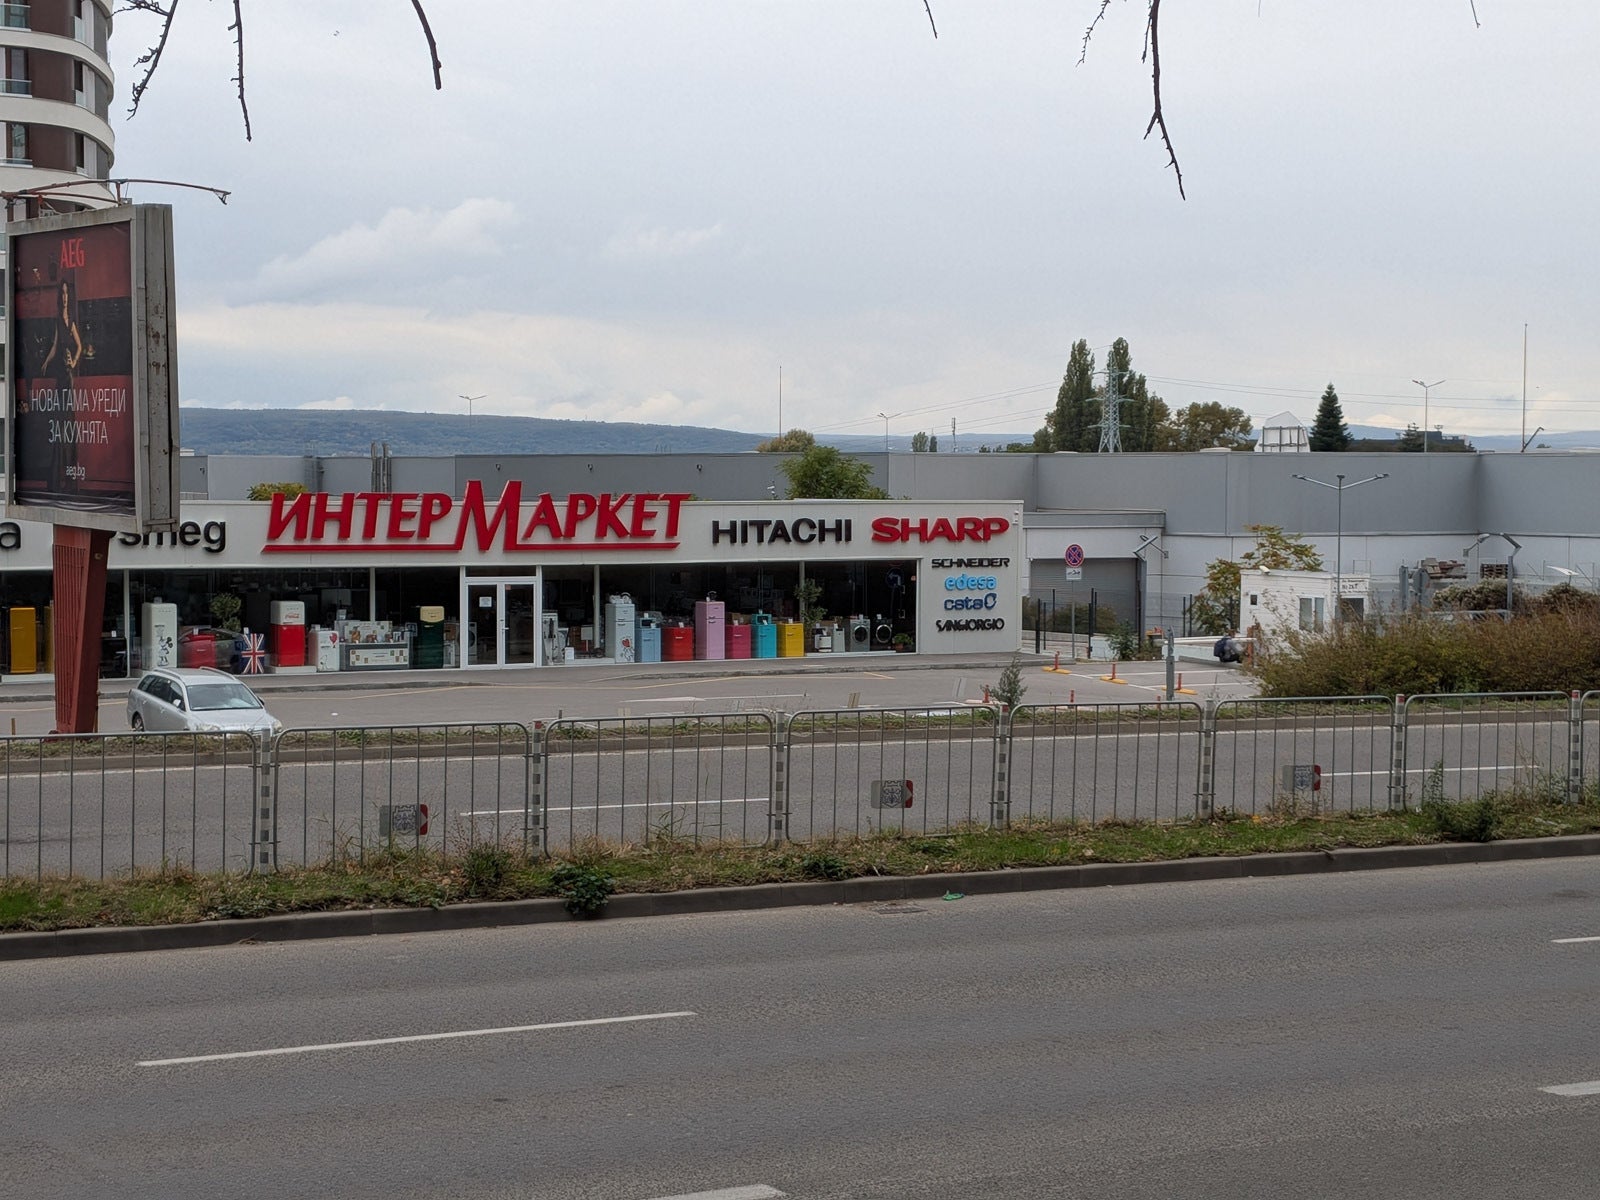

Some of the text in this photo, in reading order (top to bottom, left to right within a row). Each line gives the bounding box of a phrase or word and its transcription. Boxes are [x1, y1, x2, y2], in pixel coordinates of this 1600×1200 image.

[60, 237, 85, 269] AEG
[31, 388, 126, 418] НОВА ГАМА УРЕДИ
[48, 419, 109, 444] ЗА КУХНЯТА
[66, 462, 86, 480] aeg.bg
[712, 518, 852, 544] HITACHI
[871, 516, 1010, 543] SHARP
[931, 557, 1011, 569] SCHNEIDER
[945, 573, 997, 591] edesa
[935, 618, 1005, 632] SANGIORGIO
